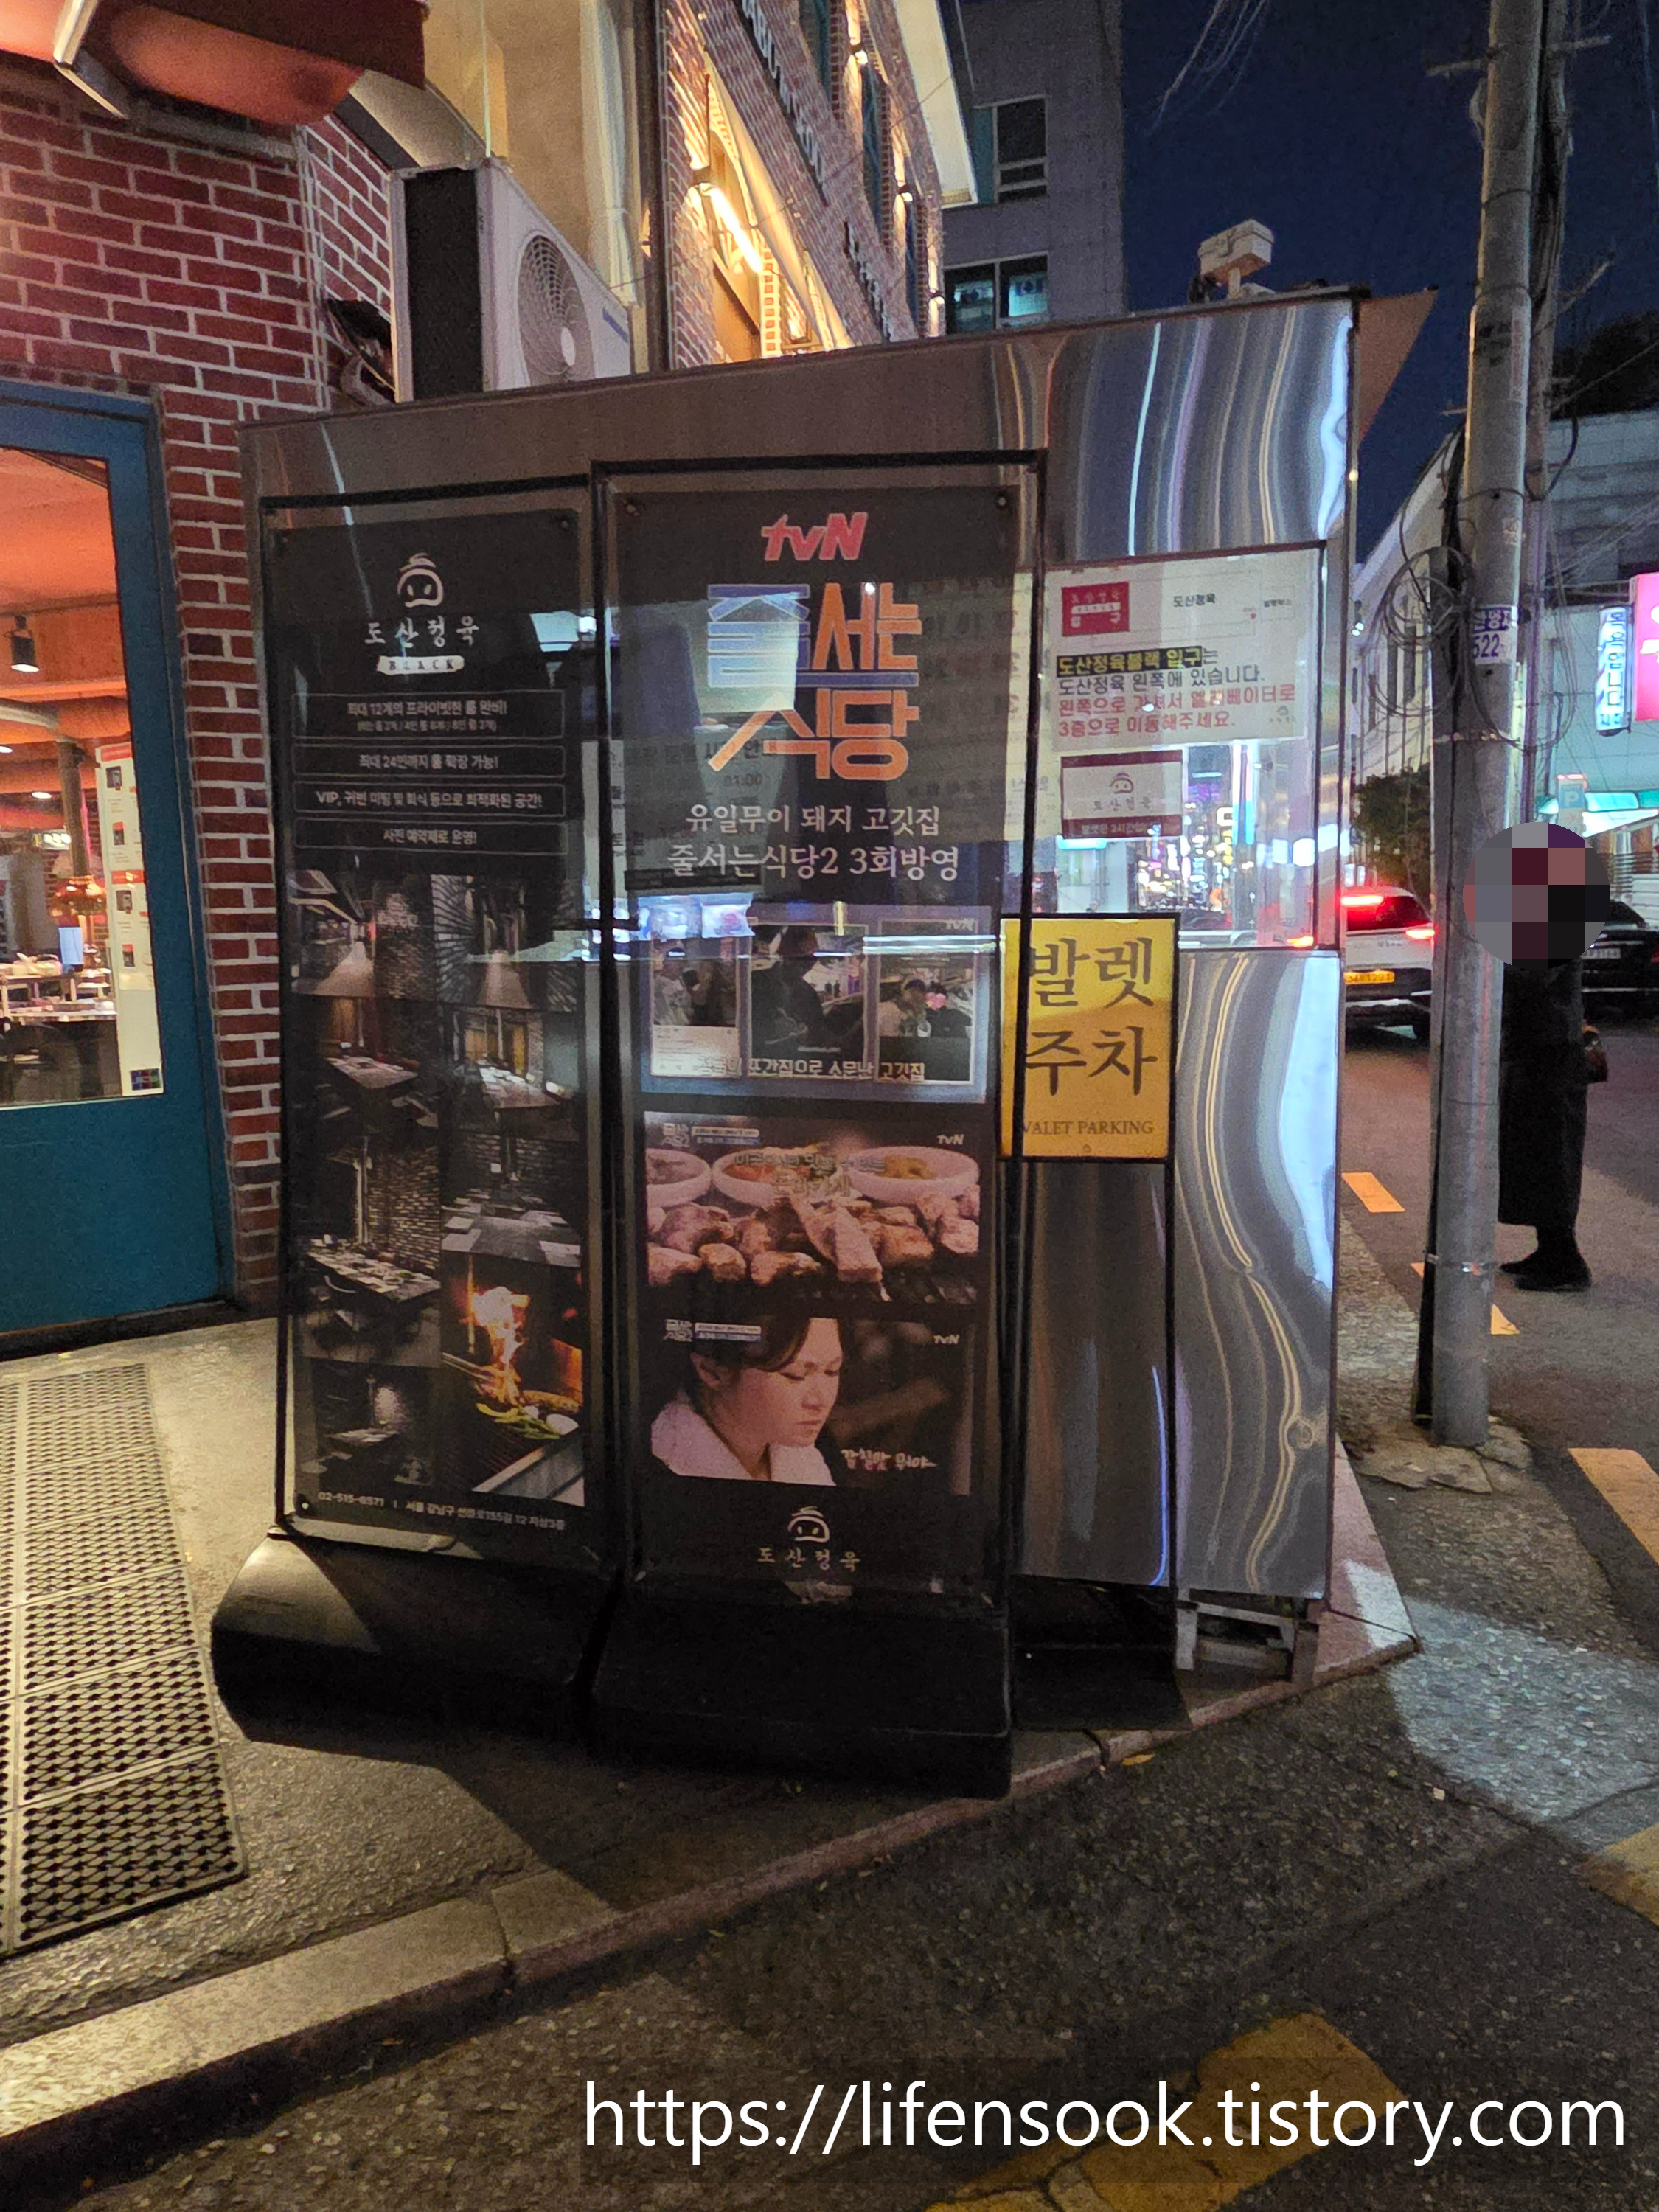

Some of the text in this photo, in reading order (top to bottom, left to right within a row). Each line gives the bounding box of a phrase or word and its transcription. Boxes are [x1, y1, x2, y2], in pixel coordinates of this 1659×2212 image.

[761, 512, 868, 560] tvN
[364, 616, 479, 647] 도산정육
[707, 582, 922, 687] 줄서는
[389, 659, 454, 671] BLACK
[1058, 665, 1265, 696] 도산정육 왼쪽에 있습니다.
[1059, 698, 1126, 717] 왼쪽으로
[707, 689, 920, 781] 식당
[1059, 710, 1235, 737] 3층으로 이동해주세요.
[686, 804, 940, 836] 유일무이 돼지 고깃집
[667, 844, 959, 881] 줄서는식당2 3회방영
[1029, 937, 1155, 1009] 발렛
[1026, 1026, 1158, 1096] 주차
[1078, 1121, 1155, 1135] PARKING
[757, 1547, 861, 1573] 도산정육
